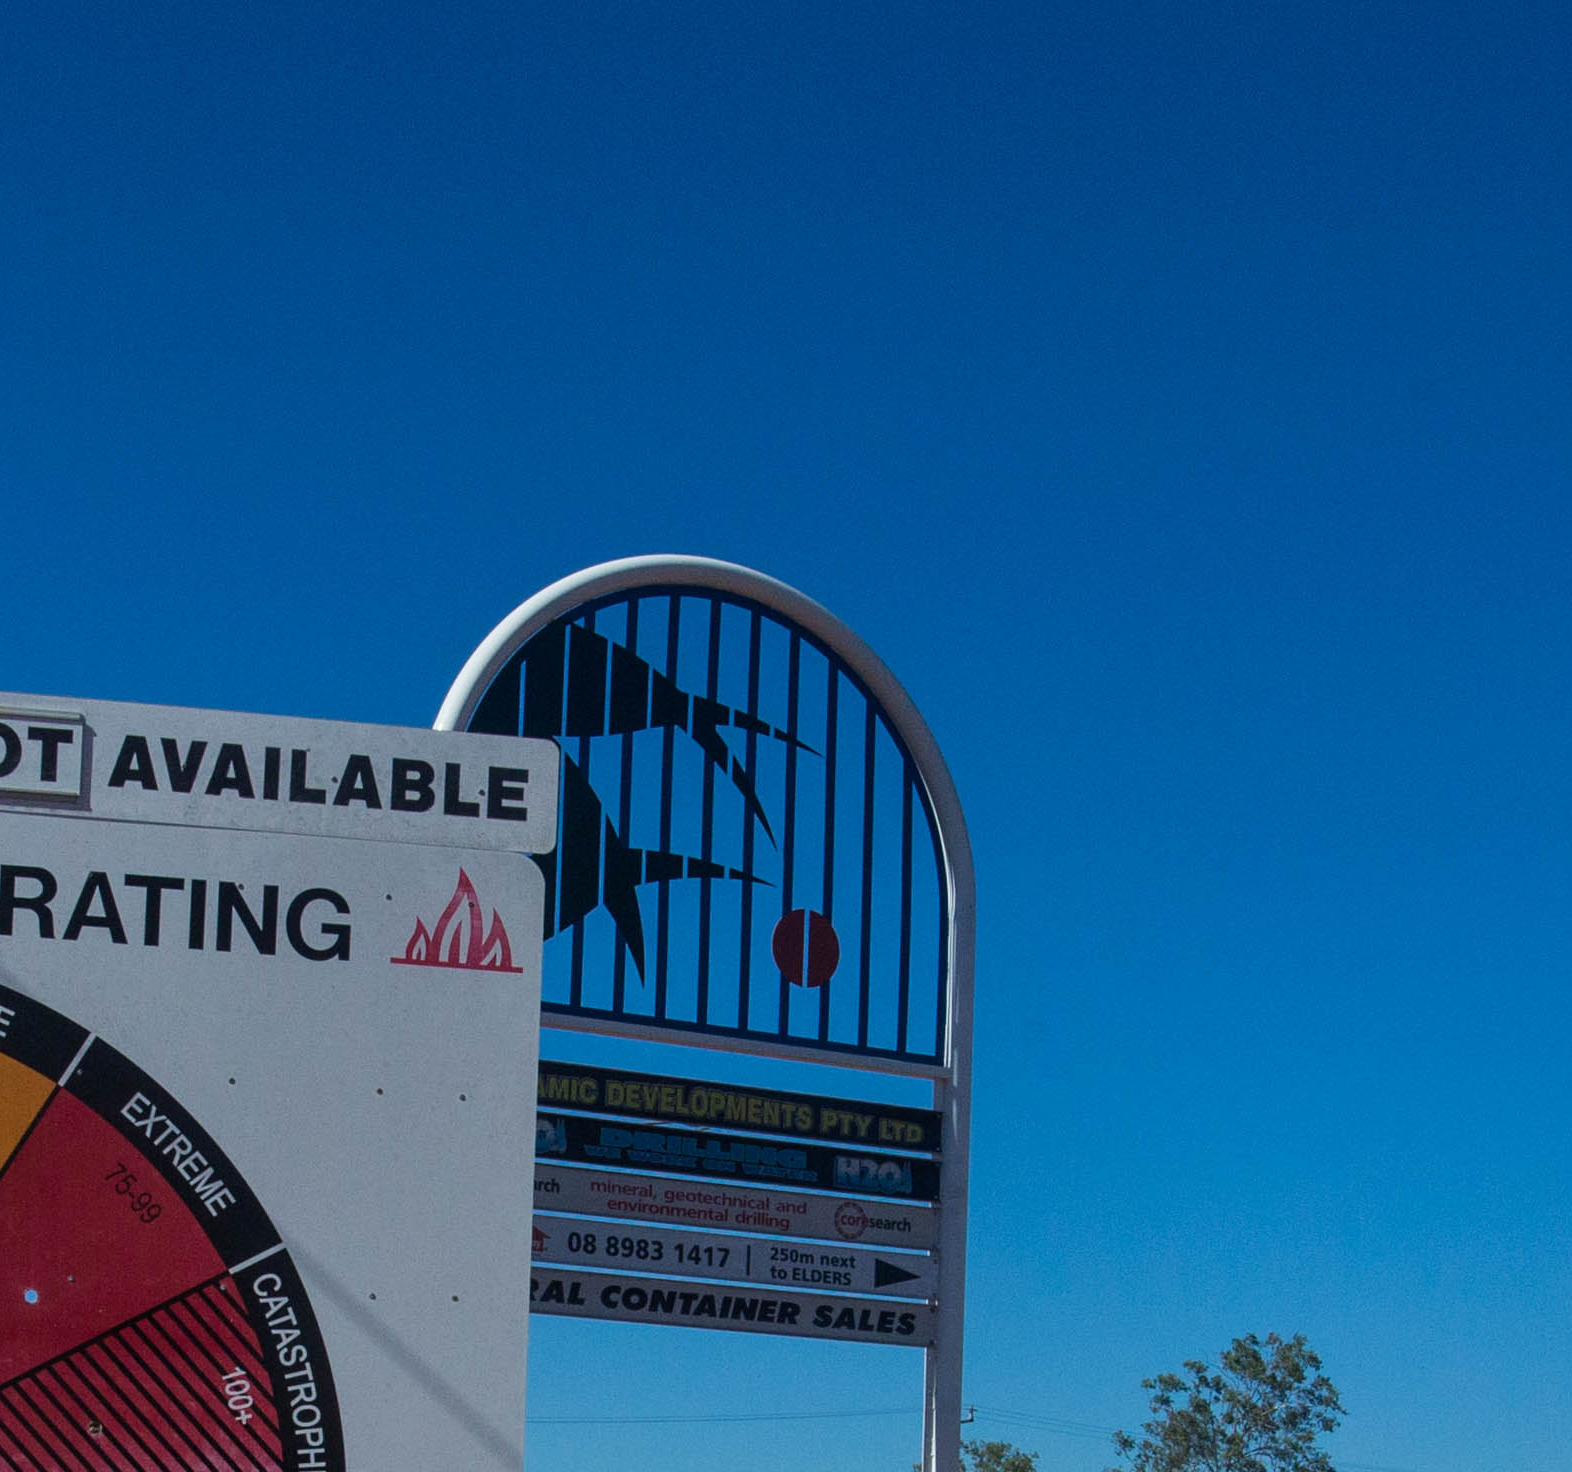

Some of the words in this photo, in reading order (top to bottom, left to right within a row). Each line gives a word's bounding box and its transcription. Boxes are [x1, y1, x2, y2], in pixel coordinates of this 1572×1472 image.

[108, 734, 529, 822] AVAILABLE
[605, 1079, 814, 1132] DEVELOPMENTS
[819, 1107, 875, 1138] PTY
[878, 1118, 924, 1144] LTD
[120, 1091, 236, 1217] EXTREME
[104, 1162, 162, 1224] 75-99
[590, 1180, 657, 1200] mineral,
[664, 1189, 770, 1211] geotechnical
[776, 1201, 808, 1216] and
[607, 1199, 729, 1223] environmental
[735, 1211, 791, 1232] drilling
[567, 1231, 597, 1255] 08
[605, 1236, 664, 1261] 8983
[674, 1243, 731, 1268] 1417
[770, 1246, 815, 1266] 250m
[820, 1252, 856, 1269] next
[770, 1267, 788, 1281] to
[792, 1267, 852, 1286] ELDERS
[599, 1285, 802, 1326] CONTAINER
[812, 1305, 917, 1336] SALES
[221, 1366, 254, 1426] 100+
